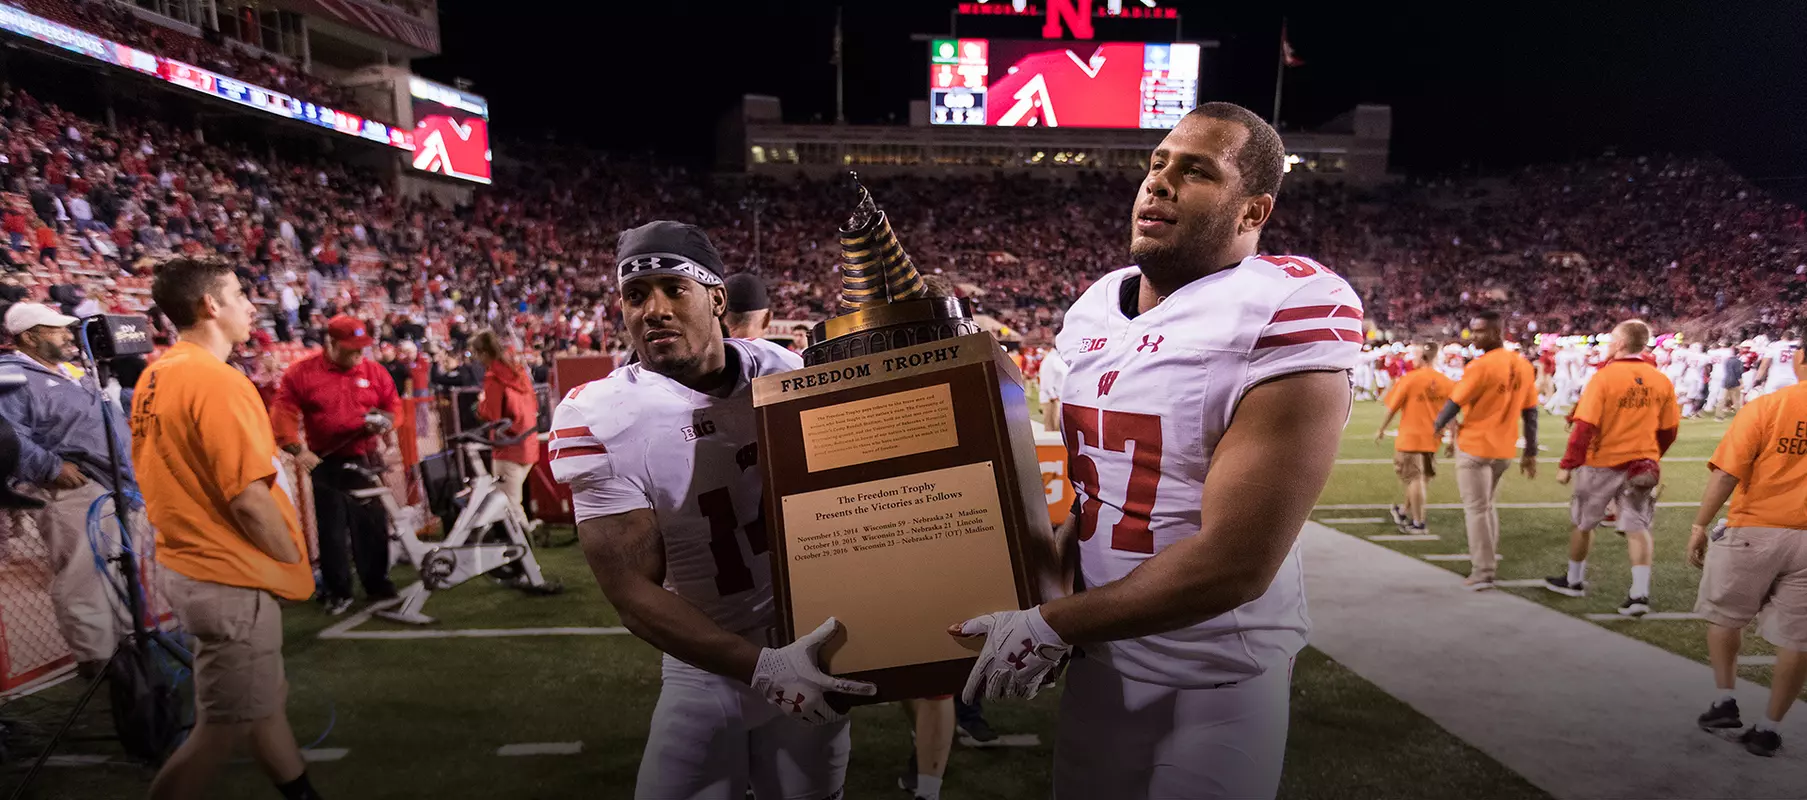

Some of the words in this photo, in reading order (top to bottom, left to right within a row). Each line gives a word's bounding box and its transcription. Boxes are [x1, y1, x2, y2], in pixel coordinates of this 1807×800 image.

[1042, 0, 1095, 39] N
[781, 363, 871, 393] FREEDOM
[883, 345, 960, 372] TROPHY
[1097, 371, 1120, 399] W
[837, 495, 856, 505] The
[857, 487, 899, 502] Freedom
[900, 482, 936, 496] Trophy
[1061, 402, 1163, 555] 57
[816, 508, 852, 521] Presents
[854, 504, 869, 515] the
[871, 497, 912, 512] Victories
[914, 496, 924, 505] as
[926, 490, 963, 504] Follows
[794, 551, 820, 561] October
[833, 547, 847, 555] 2016
[852, 541, 885, 552] Wisconsin
[902, 533, 932, 544] Nebraska
[944, 529, 962, 537] (OT)
[964, 523, 994, 534] Madison
[797, 532, 830, 543] November
[863, 521, 896, 532] Wisconsin
[912, 514, 943, 524] Nebraska
[958, 507, 987, 517] Madison
[803, 541, 830, 551] October
[842, 537, 856, 545] 2015
[861, 531, 894, 541] Wisconsin
[911, 523, 942, 533] Nebraska
[956, 516, 982, 526] Lincoln
